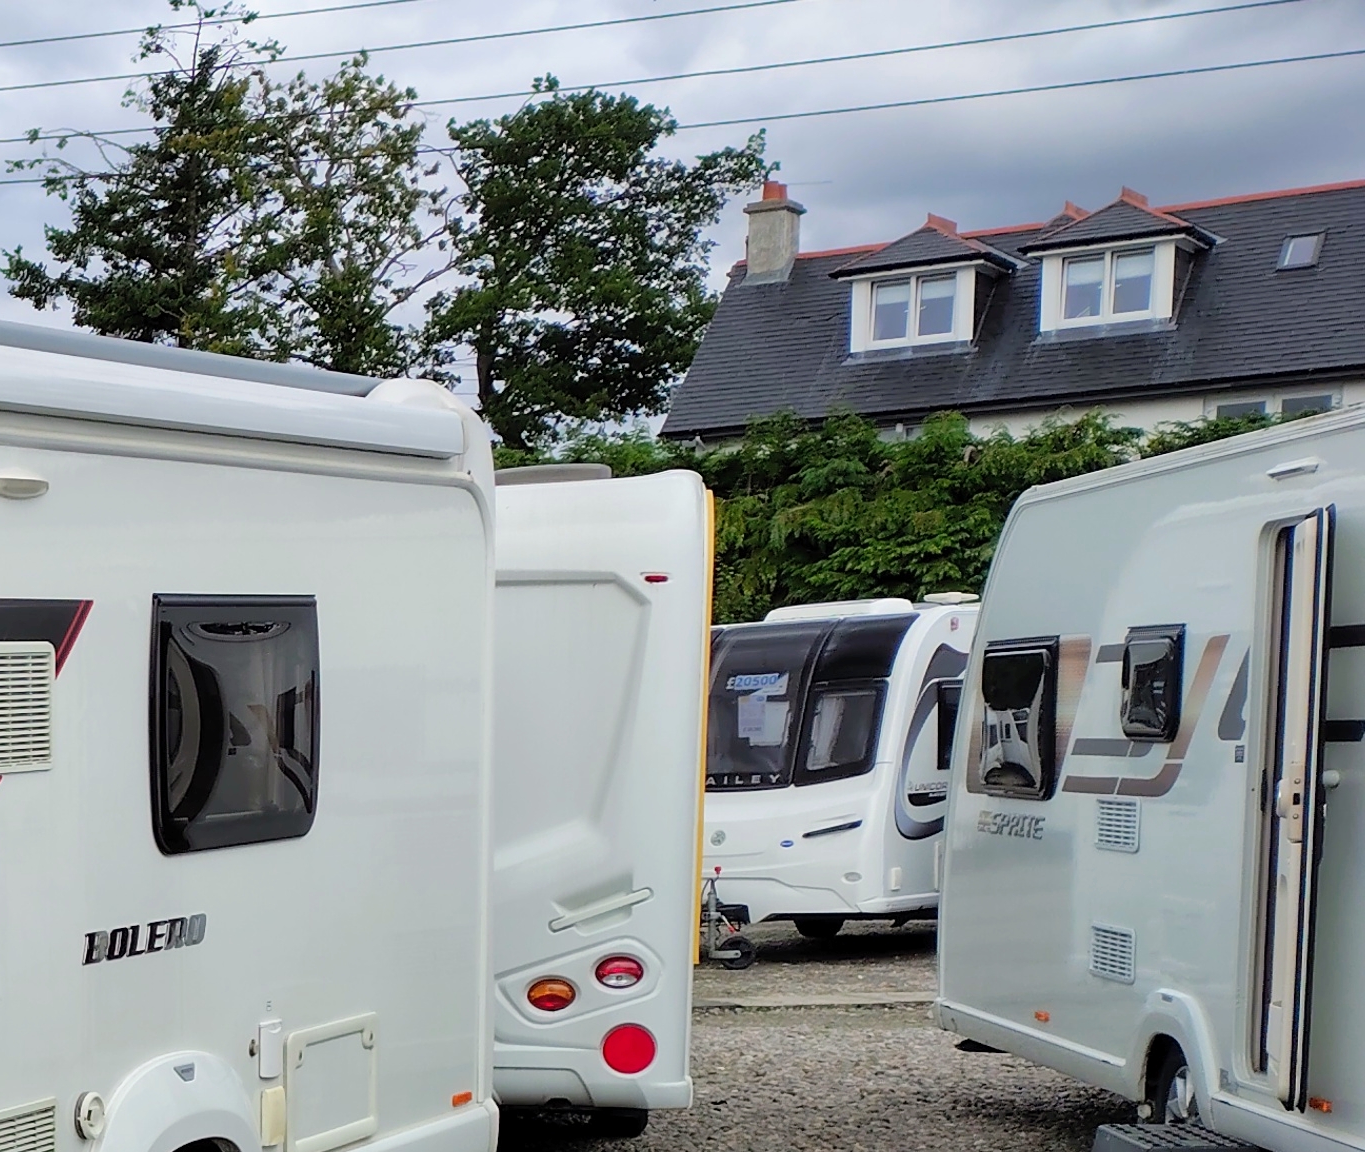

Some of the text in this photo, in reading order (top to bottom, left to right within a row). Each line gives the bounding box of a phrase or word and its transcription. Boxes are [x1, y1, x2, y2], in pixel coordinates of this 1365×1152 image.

[725, 674, 778, 691] £20500
[705, 774, 781, 786] AILEY
[914, 781, 948, 792] UNICOR
[991, 812, 1046, 840] SPRITE
[81, 912, 207, 966] BOLERO
